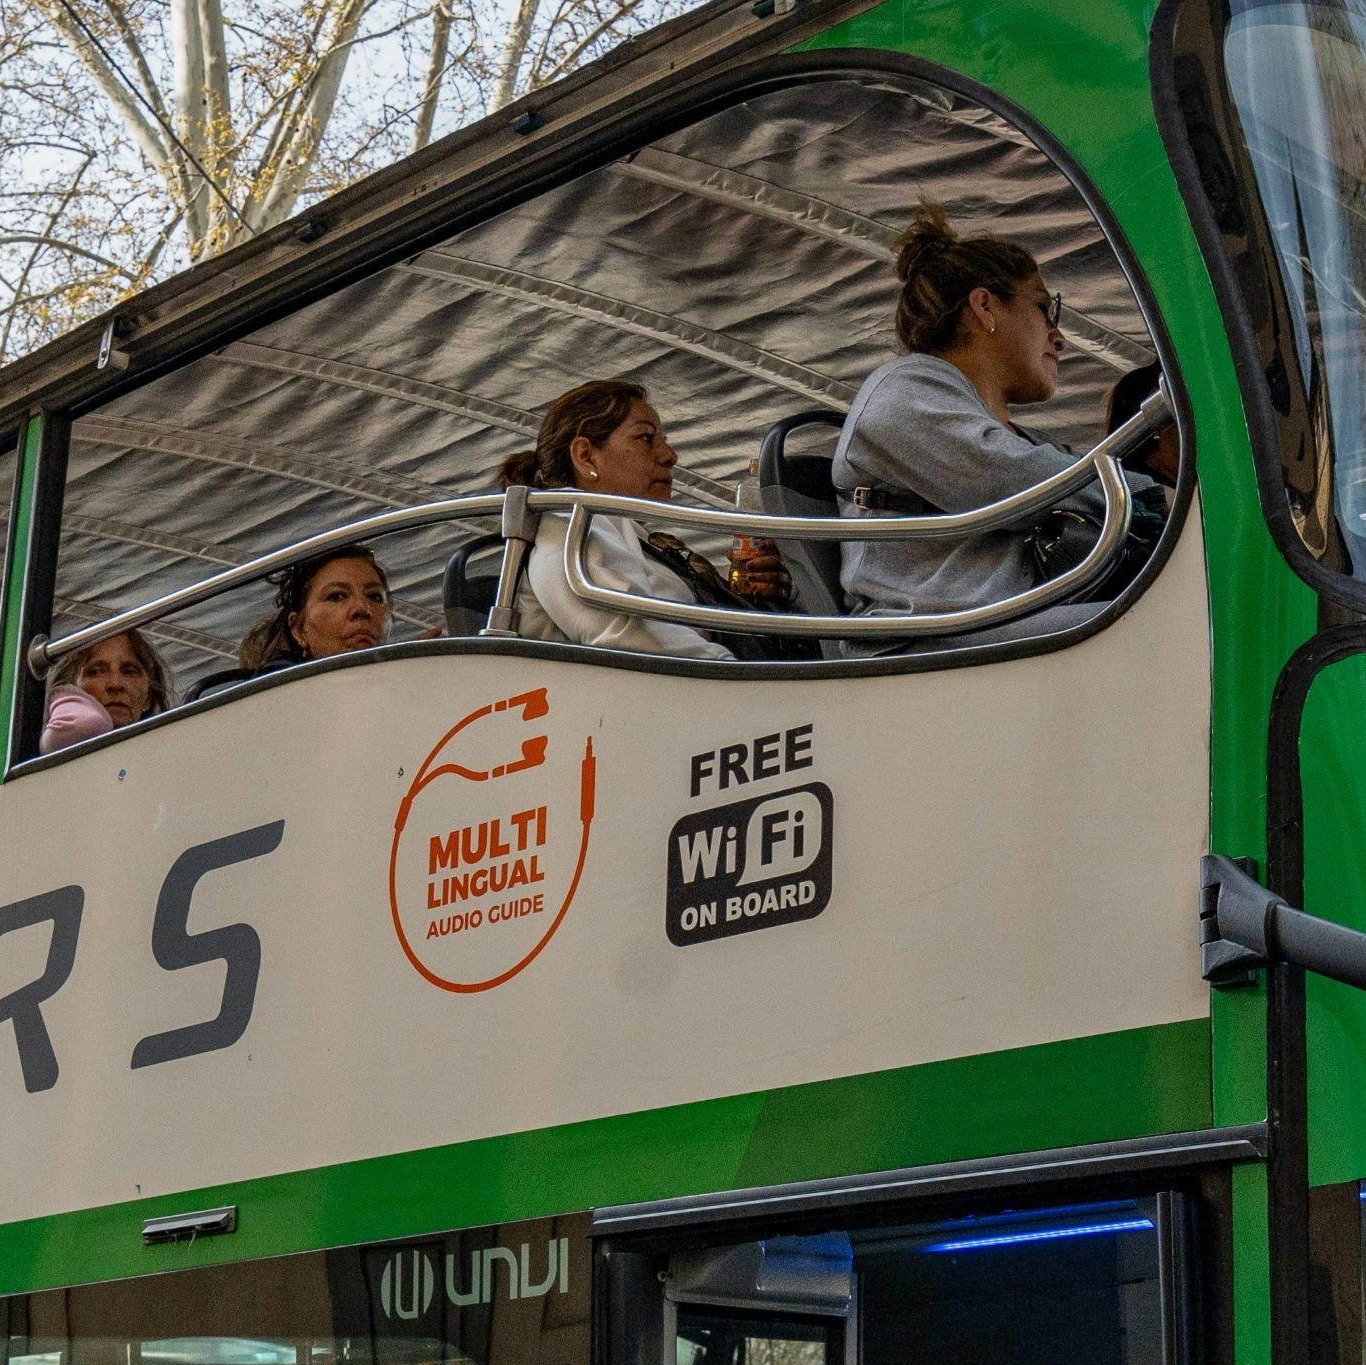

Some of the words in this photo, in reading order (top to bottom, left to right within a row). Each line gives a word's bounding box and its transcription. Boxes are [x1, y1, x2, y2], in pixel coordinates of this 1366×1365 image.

[690, 723, 813, 798] FREE
[428, 806, 547, 875] MULTI
[678, 810, 804, 885] WiFi
[427, 856, 544, 909] LINGUAL
[680, 898, 718, 931] ON
[725, 880, 815, 922] BOARD
[426, 909, 482, 940] AUDIO
[488, 894, 544, 925] GUIDE
